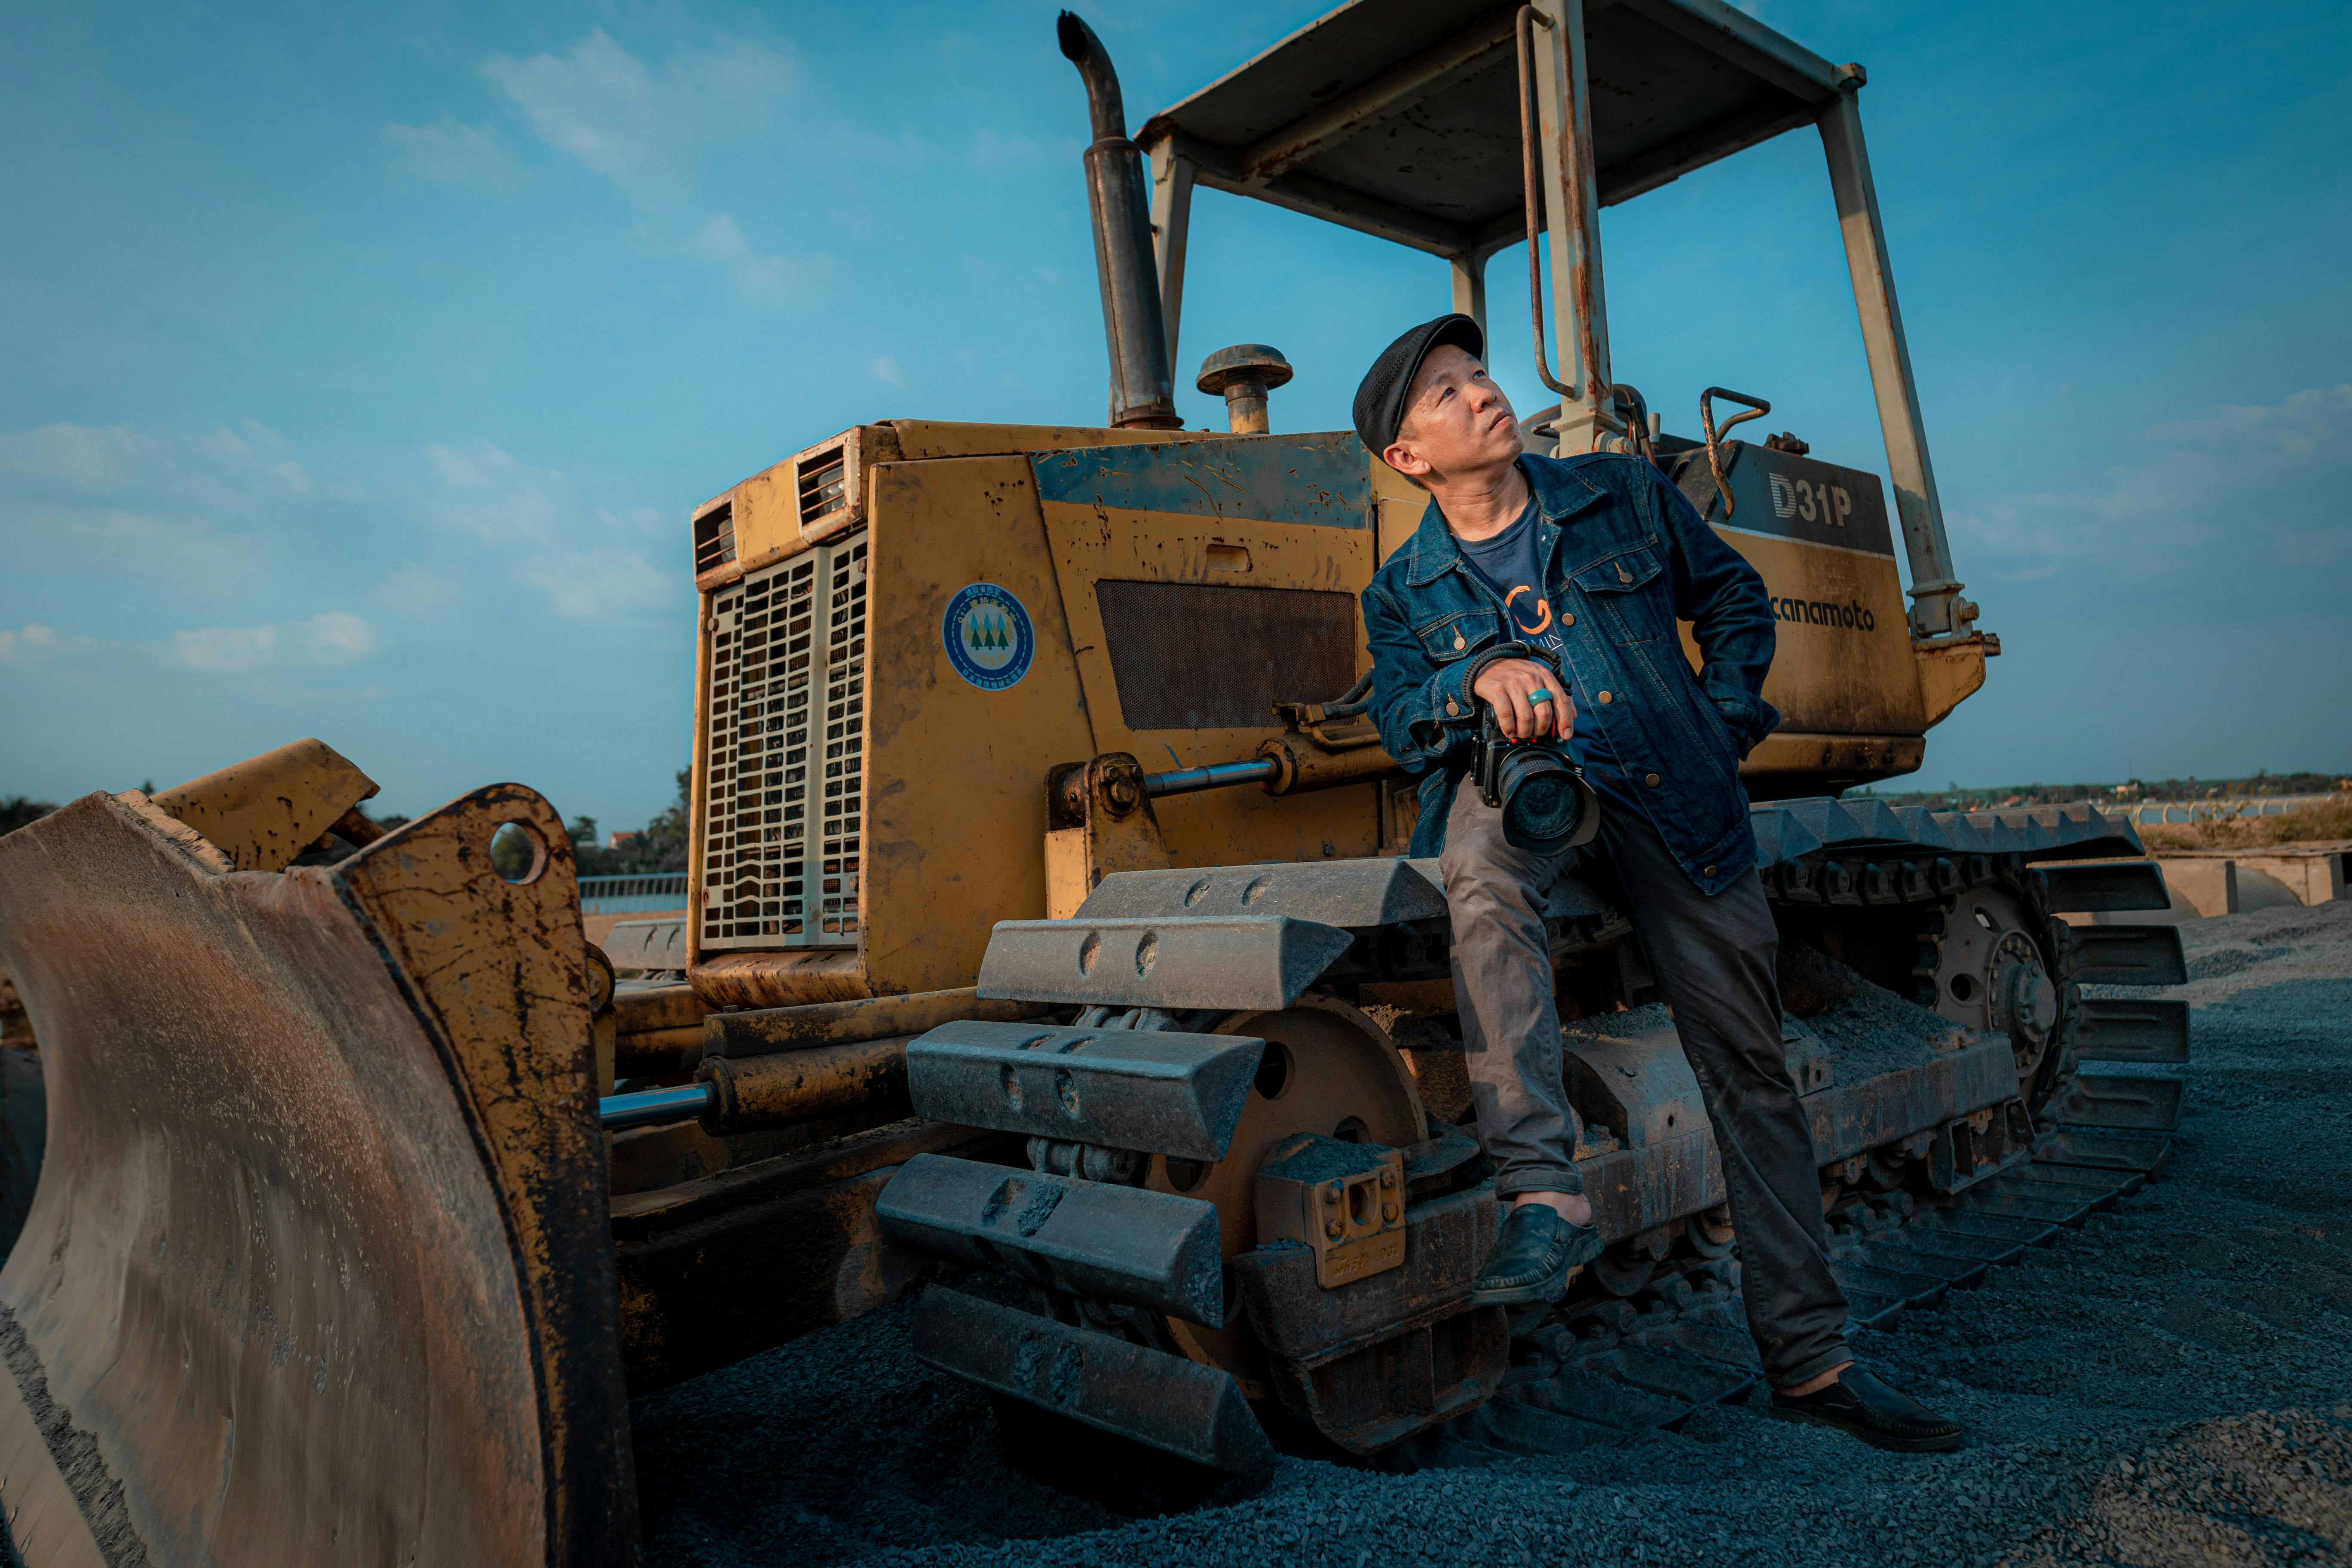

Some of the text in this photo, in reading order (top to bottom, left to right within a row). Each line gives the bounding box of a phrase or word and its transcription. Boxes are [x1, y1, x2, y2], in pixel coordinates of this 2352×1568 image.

[1769, 472, 1851, 527] D31P
[965, 585, 1001, 597] 建設省指定
